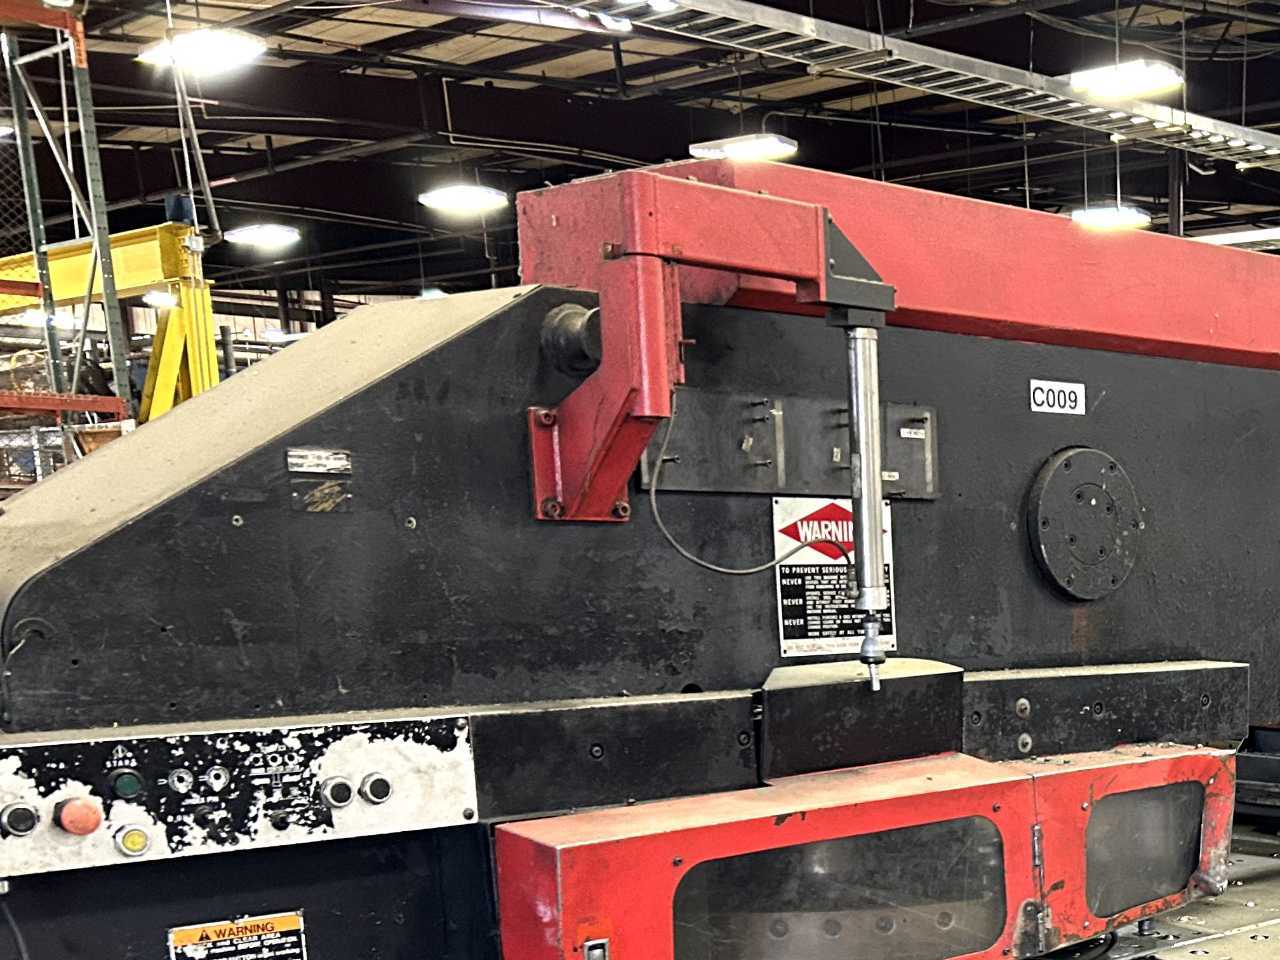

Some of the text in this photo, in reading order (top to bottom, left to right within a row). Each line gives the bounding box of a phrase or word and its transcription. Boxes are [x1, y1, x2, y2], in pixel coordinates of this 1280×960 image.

[1033, 386, 1077, 410] C009
[797, 520, 853, 542] WARNI
[781, 566, 790, 574] TO
[792, 566, 820, 574] PREVENT
[782, 578, 802, 586] NEVER
[783, 598, 803, 606] NEVER
[784, 618, 804, 626] NEVER
[214, 921, 275, 938] WARNING
